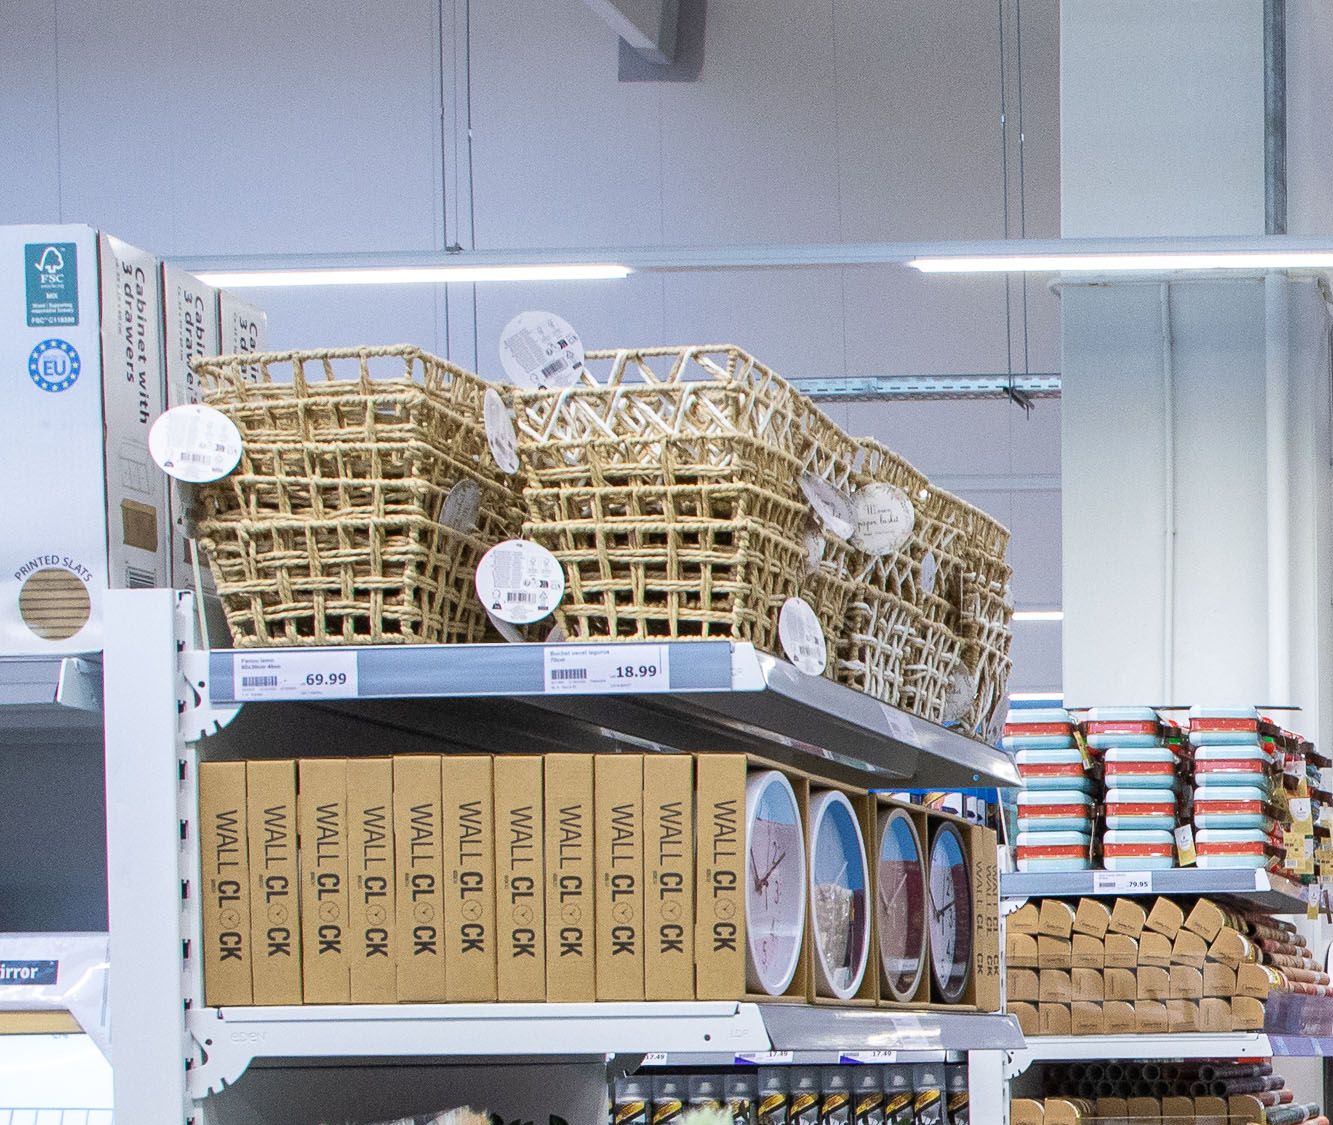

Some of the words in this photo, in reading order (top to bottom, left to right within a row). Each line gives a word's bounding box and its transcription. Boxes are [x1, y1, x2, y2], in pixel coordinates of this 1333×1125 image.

[41, 273, 64, 283] FSC
[122, 261, 133, 275] 3
[124, 283, 135, 383] drawers
[135, 267, 148, 365] Cabinet
[43, 360, 67, 376] EU
[138, 371, 150, 424] with
[14, 555, 60, 582] PRINTED
[62, 556, 94, 582] SLATS
[306, 673, 347, 686] 69.99
[616, 665, 657, 678] 18.99
[216, 809, 239, 874] WALL
[264, 805, 288, 870] WALL
[316, 803, 339, 867] WALL
[363, 806, 386, 870] WALL
[410, 803, 434, 868] WALL
[459, 800, 482, 866] WALL
[510, 806, 534, 871] WALL
[559, 804, 582, 870] WALL
[611, 803, 634, 868] WALL
[659, 802, 683, 866] WALL
[713, 800, 737, 864] WALL
[0, 963, 39, 979] irror
